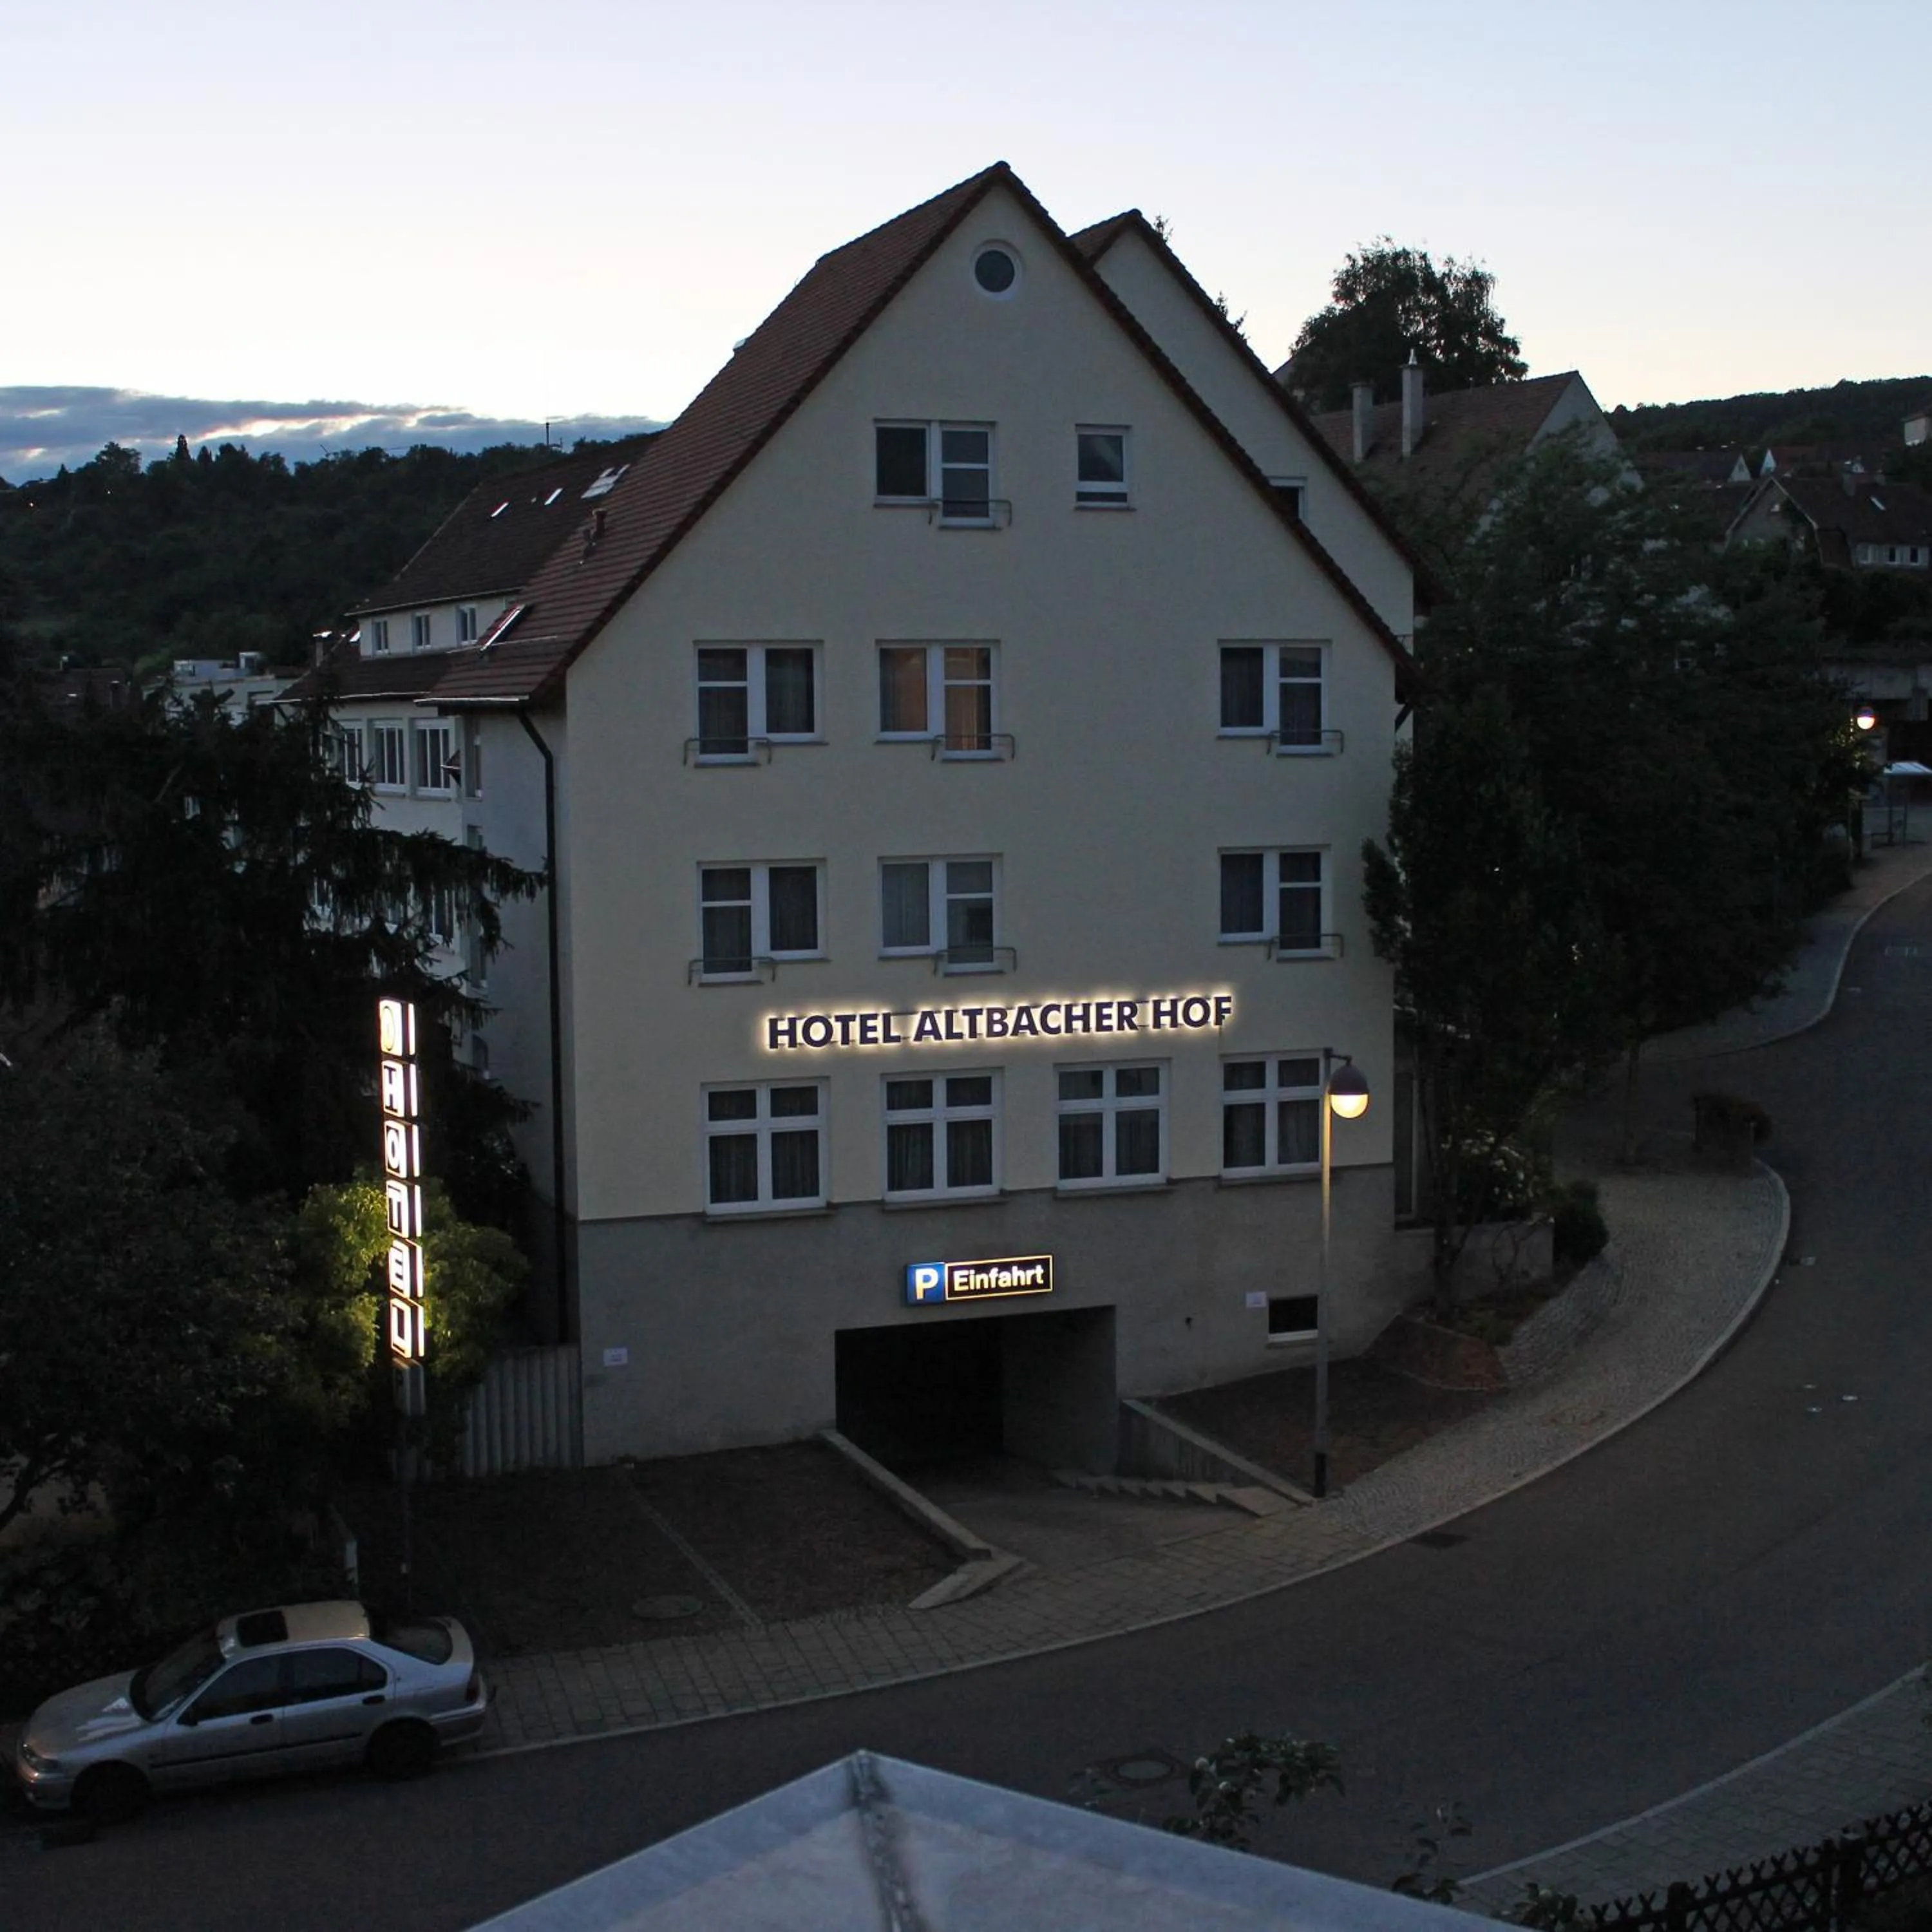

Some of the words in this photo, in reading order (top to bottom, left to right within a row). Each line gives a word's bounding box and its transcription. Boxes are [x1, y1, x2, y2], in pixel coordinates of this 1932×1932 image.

[769, 1013, 901, 1049] HOTEL
[913, 1001, 1139, 1042] ALTBACHER
[1153, 996, 1231, 1029] HOF
[382, 1062, 406, 1355] HOTEL
[914, 1267, 939, 1300] P
[952, 1264, 1044, 1292] Einfahrt
